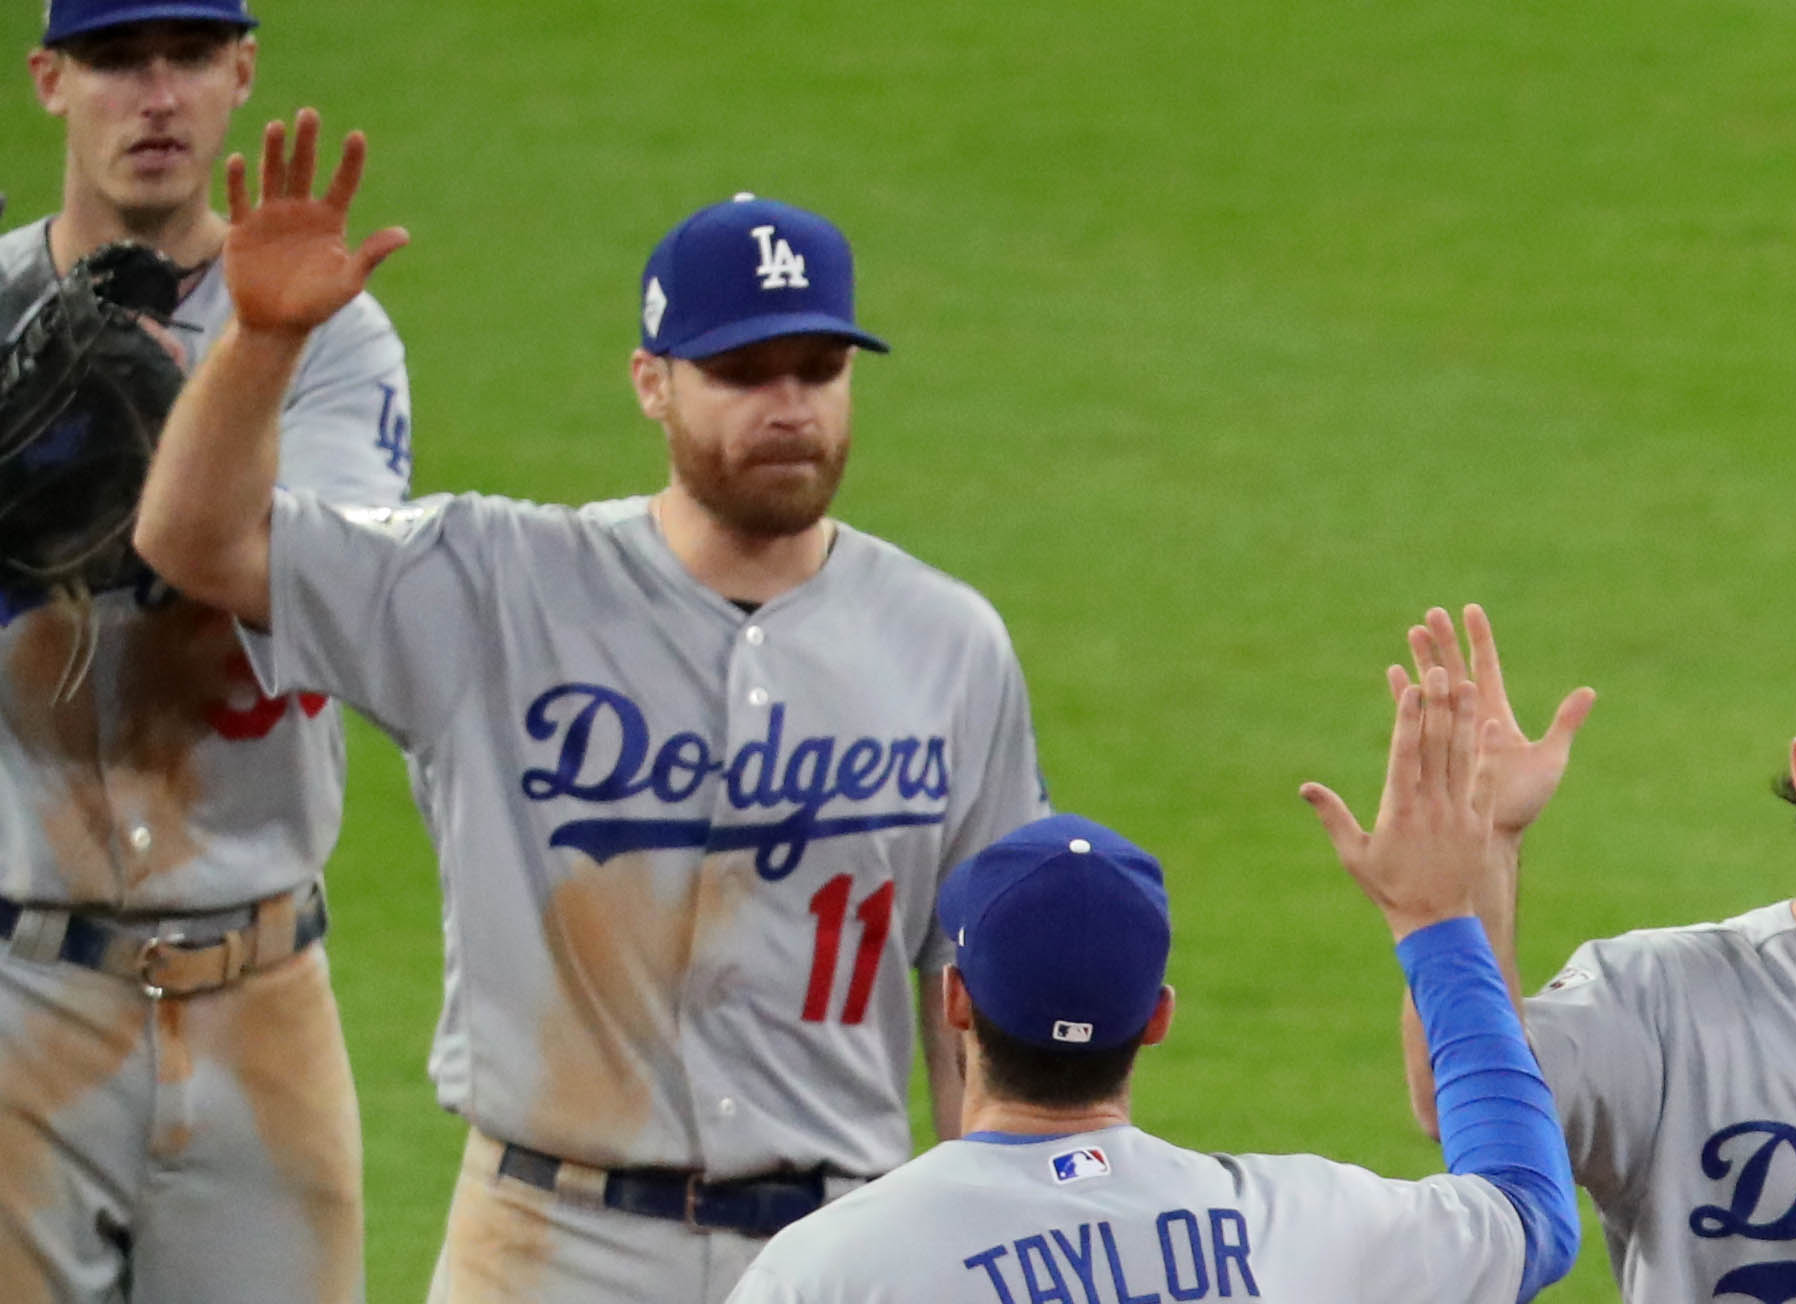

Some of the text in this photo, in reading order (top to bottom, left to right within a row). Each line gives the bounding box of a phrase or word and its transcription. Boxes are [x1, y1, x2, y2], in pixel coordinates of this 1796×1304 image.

[752, 225, 809, 289] LA
[521, 682, 950, 882] Dodgers
[801, 872, 895, 1025] 11
